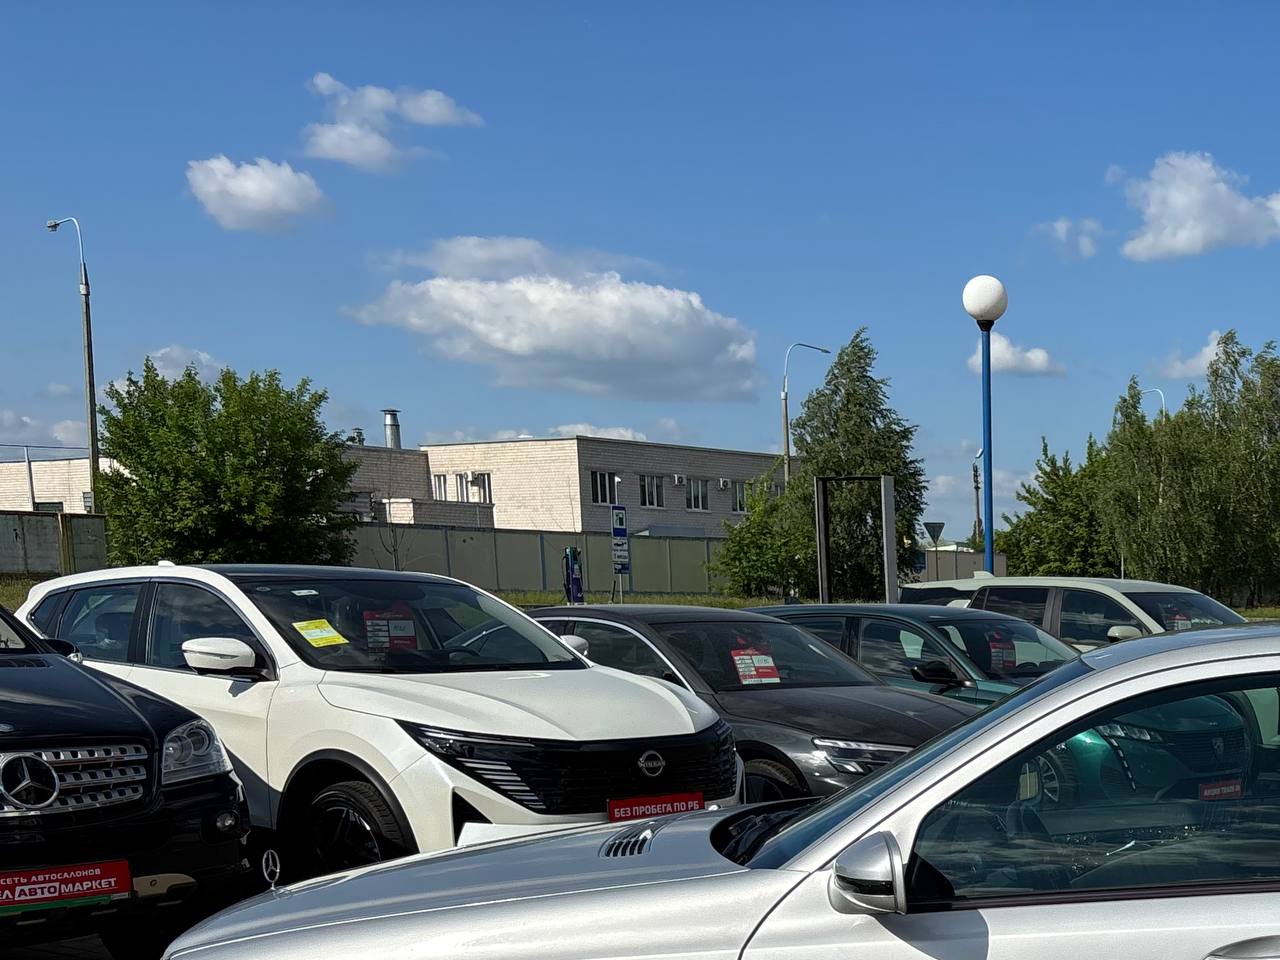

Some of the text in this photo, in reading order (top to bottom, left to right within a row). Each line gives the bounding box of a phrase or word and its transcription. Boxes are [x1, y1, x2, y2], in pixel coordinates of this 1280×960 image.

[614, 801, 700, 818] БЕЗ ПРОБЕГА ПО РБ
[0, 868, 101, 885] СЕТЬ АВТОСАЛОНОВ
